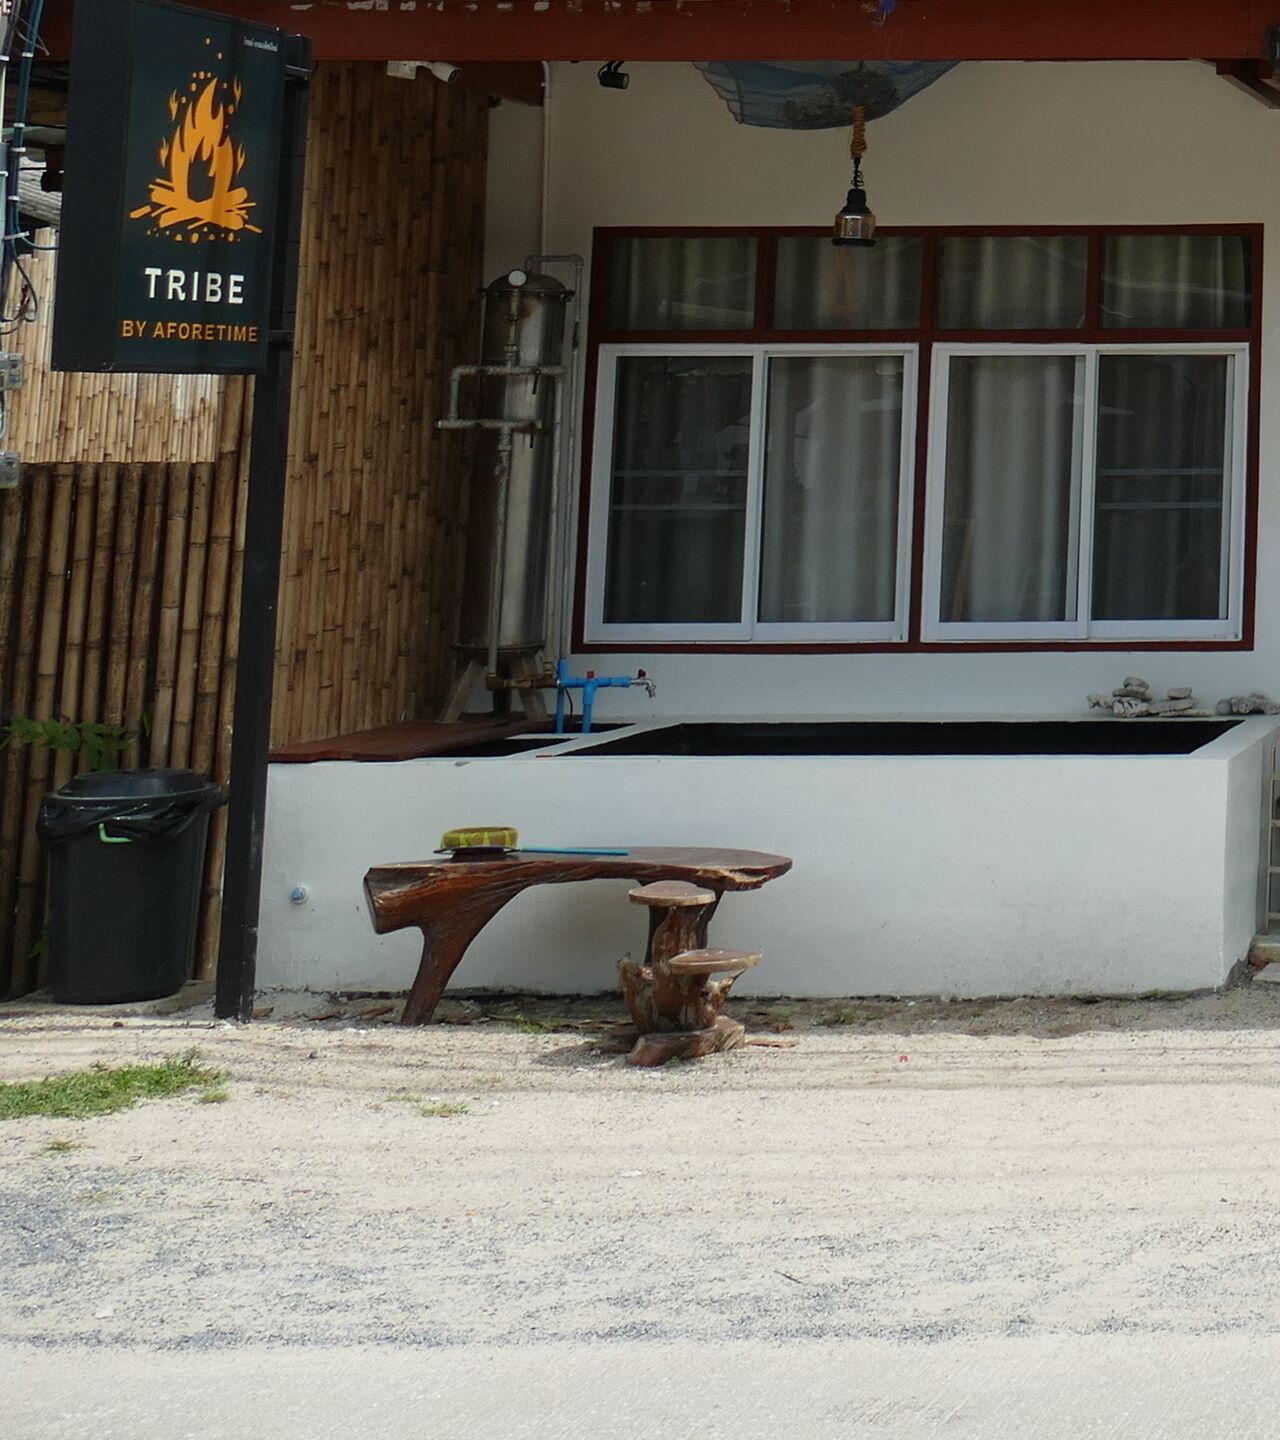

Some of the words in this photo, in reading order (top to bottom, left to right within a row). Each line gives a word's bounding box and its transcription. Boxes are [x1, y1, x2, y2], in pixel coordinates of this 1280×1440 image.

[144, 267, 245, 304] TRIBE
[121, 320, 147, 338] BY
[152, 321, 257, 342] AFORETIME
